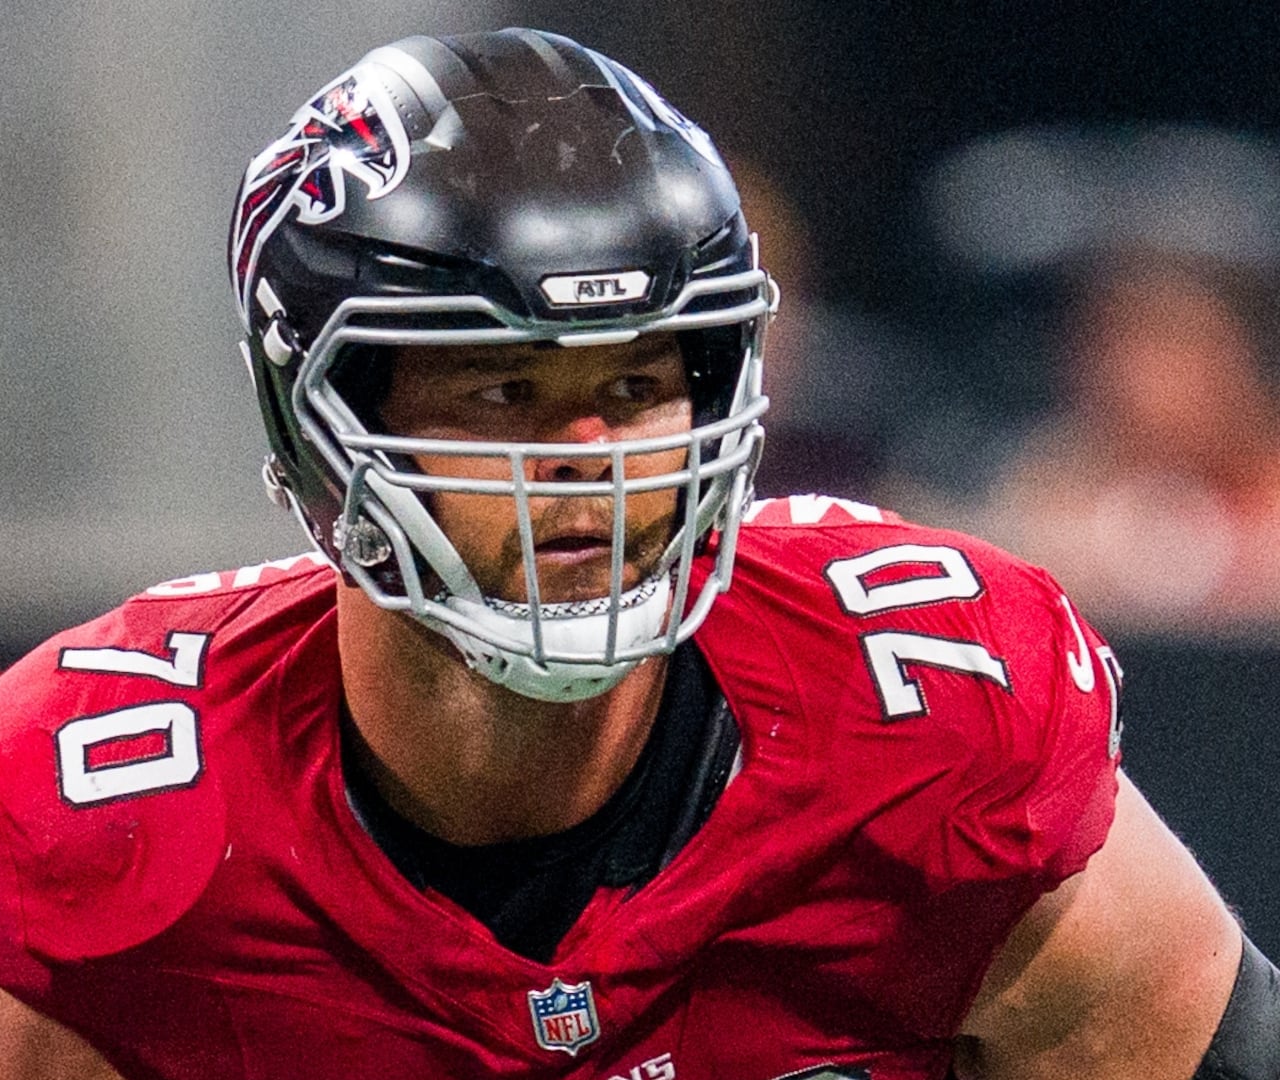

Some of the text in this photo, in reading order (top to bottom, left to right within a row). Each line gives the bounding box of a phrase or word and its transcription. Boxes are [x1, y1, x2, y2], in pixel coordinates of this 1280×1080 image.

[577, 279, 627, 297] ATL
[822, 542, 1015, 723] 70
[55, 629, 213, 811] 70
[543, 1012, 590, 1043] NFL
